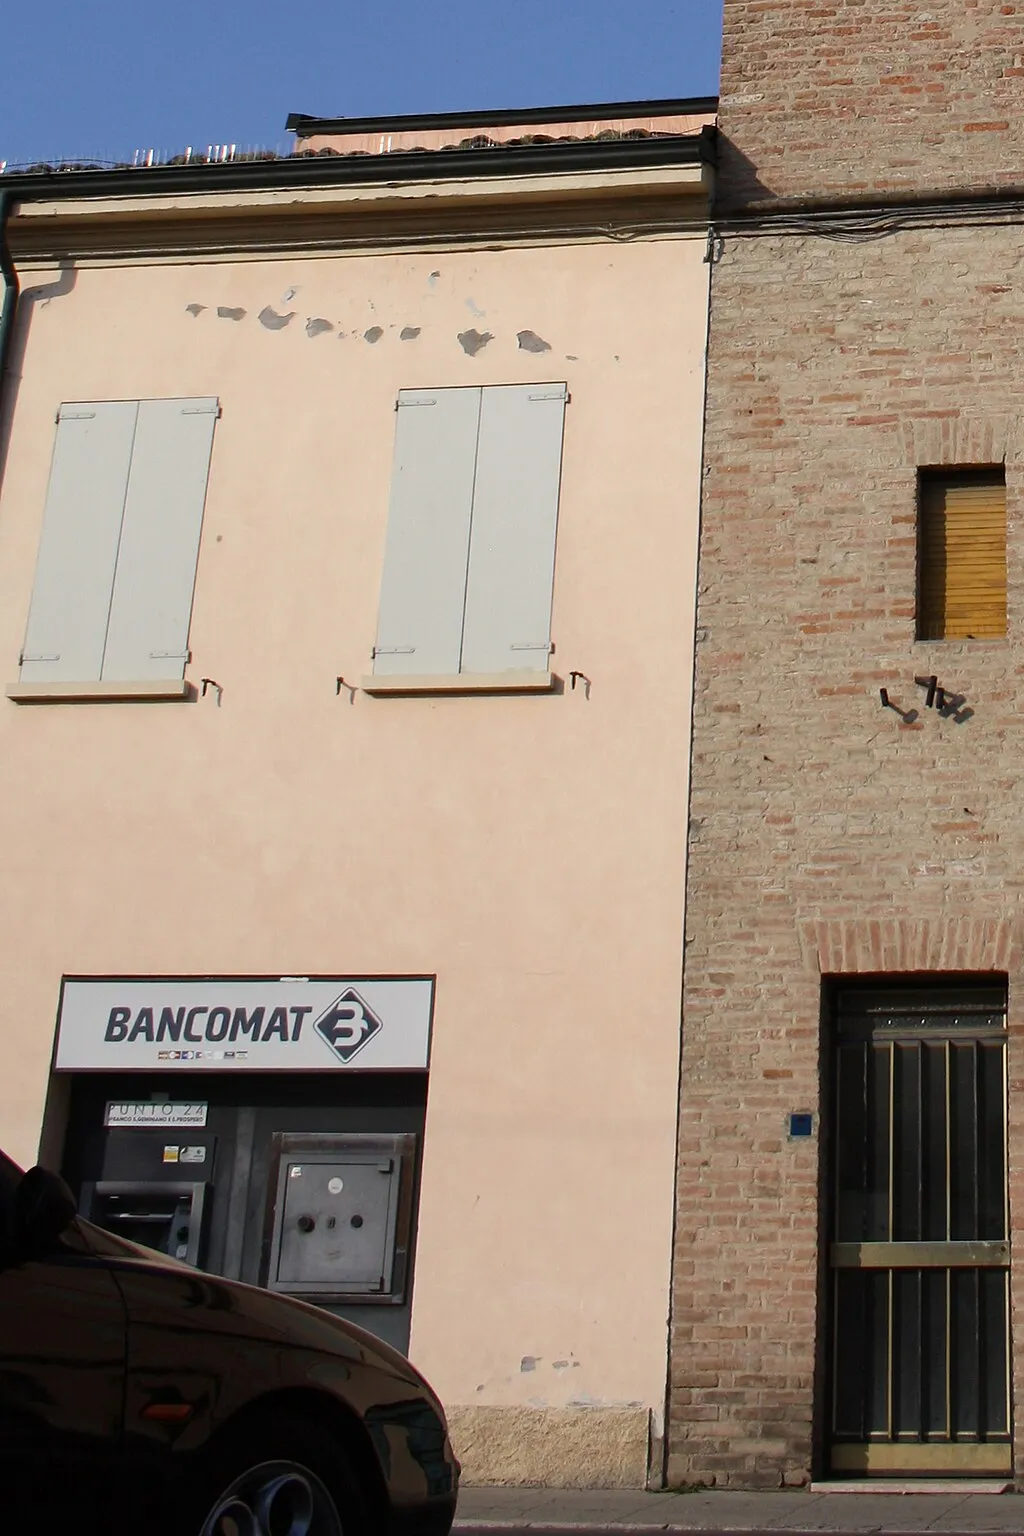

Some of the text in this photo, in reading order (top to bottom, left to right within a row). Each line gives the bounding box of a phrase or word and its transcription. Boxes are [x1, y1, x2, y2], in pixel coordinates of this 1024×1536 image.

[104, 1006, 313, 1042] BANCOMAT
[108, 1103, 203, 1116] PUNTO 24
